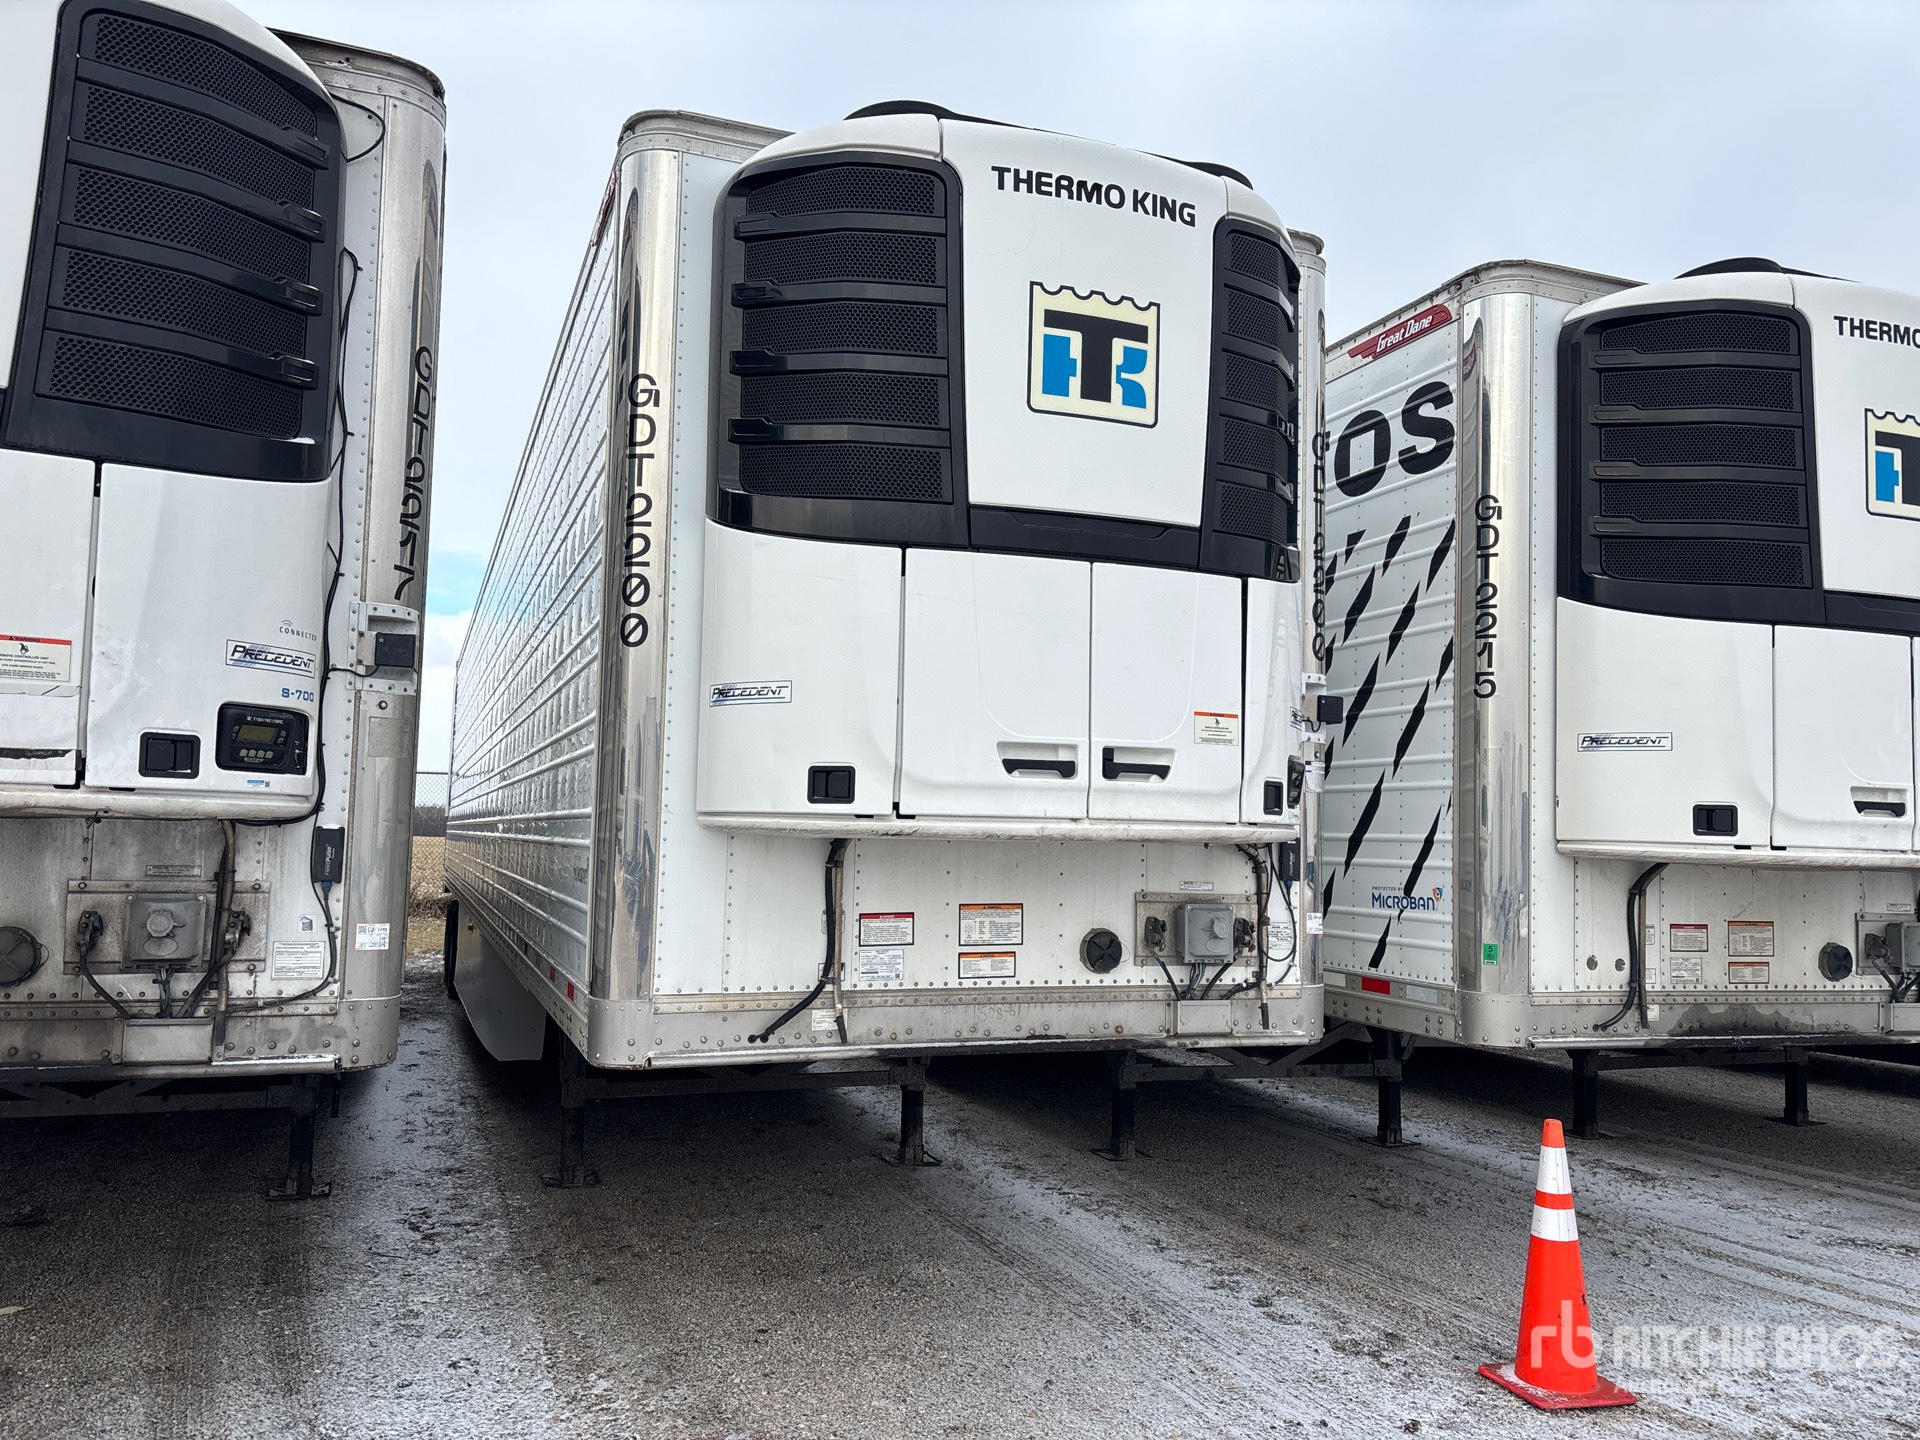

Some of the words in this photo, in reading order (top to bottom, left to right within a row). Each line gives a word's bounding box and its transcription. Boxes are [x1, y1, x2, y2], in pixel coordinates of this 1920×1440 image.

[991, 165, 1126, 210] THERMO
[1132, 188, 1196, 228] KING
[1376, 328, 1405, 353] Great
[1404, 314, 1434, 340] Dane
[619, 372, 661, 648] GDT2200
[1473, 494, 1503, 699] GDT2215
[279, 626, 318, 642] CONNECTED
[230, 644, 315, 670] PRECEDENT
[281, 687, 315, 703] S-700
[711, 684, 789, 700] PRECEDENT
[1580, 735, 1670, 747] PRECEDENT
[1371, 891, 1436, 911] MICROBAN
[1487, 945, 1494, 953] 5
